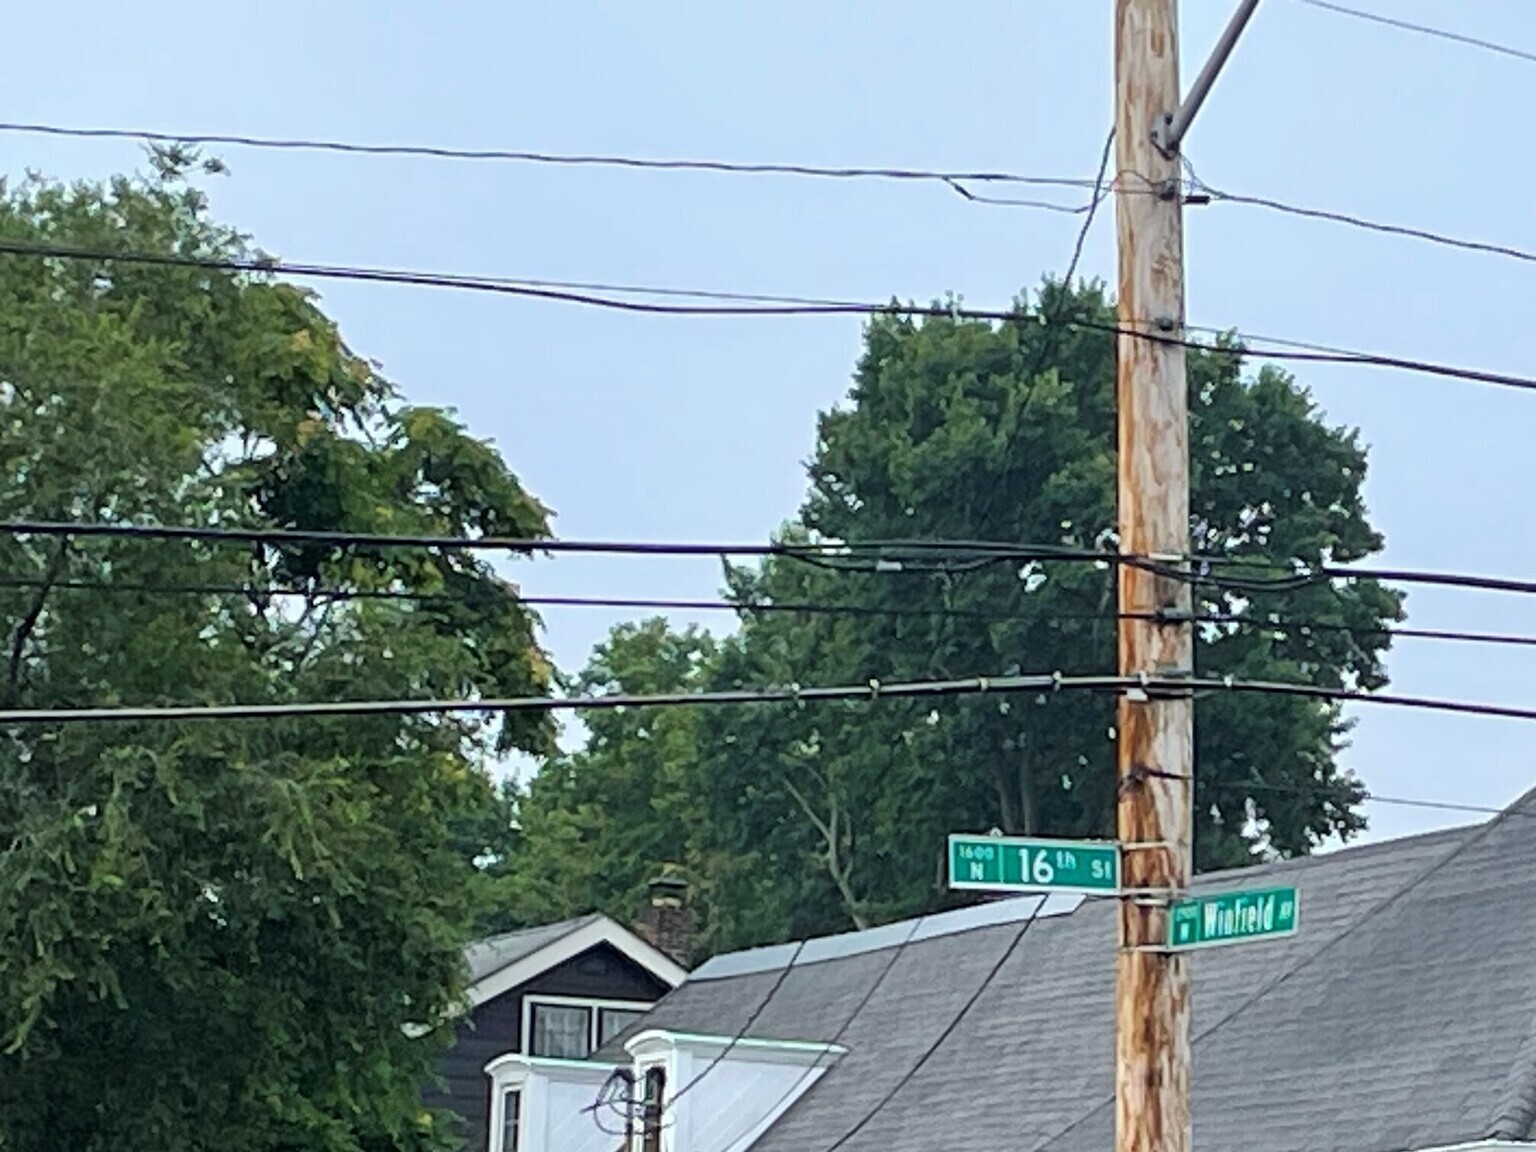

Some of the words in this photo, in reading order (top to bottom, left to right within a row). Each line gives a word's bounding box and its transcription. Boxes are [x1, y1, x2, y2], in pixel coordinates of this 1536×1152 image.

[969, 861, 984, 881] N
[1018, 848, 1077, 884] 16th
[1091, 859, 1112, 880] St
[1204, 894, 1275, 938] Winfield
